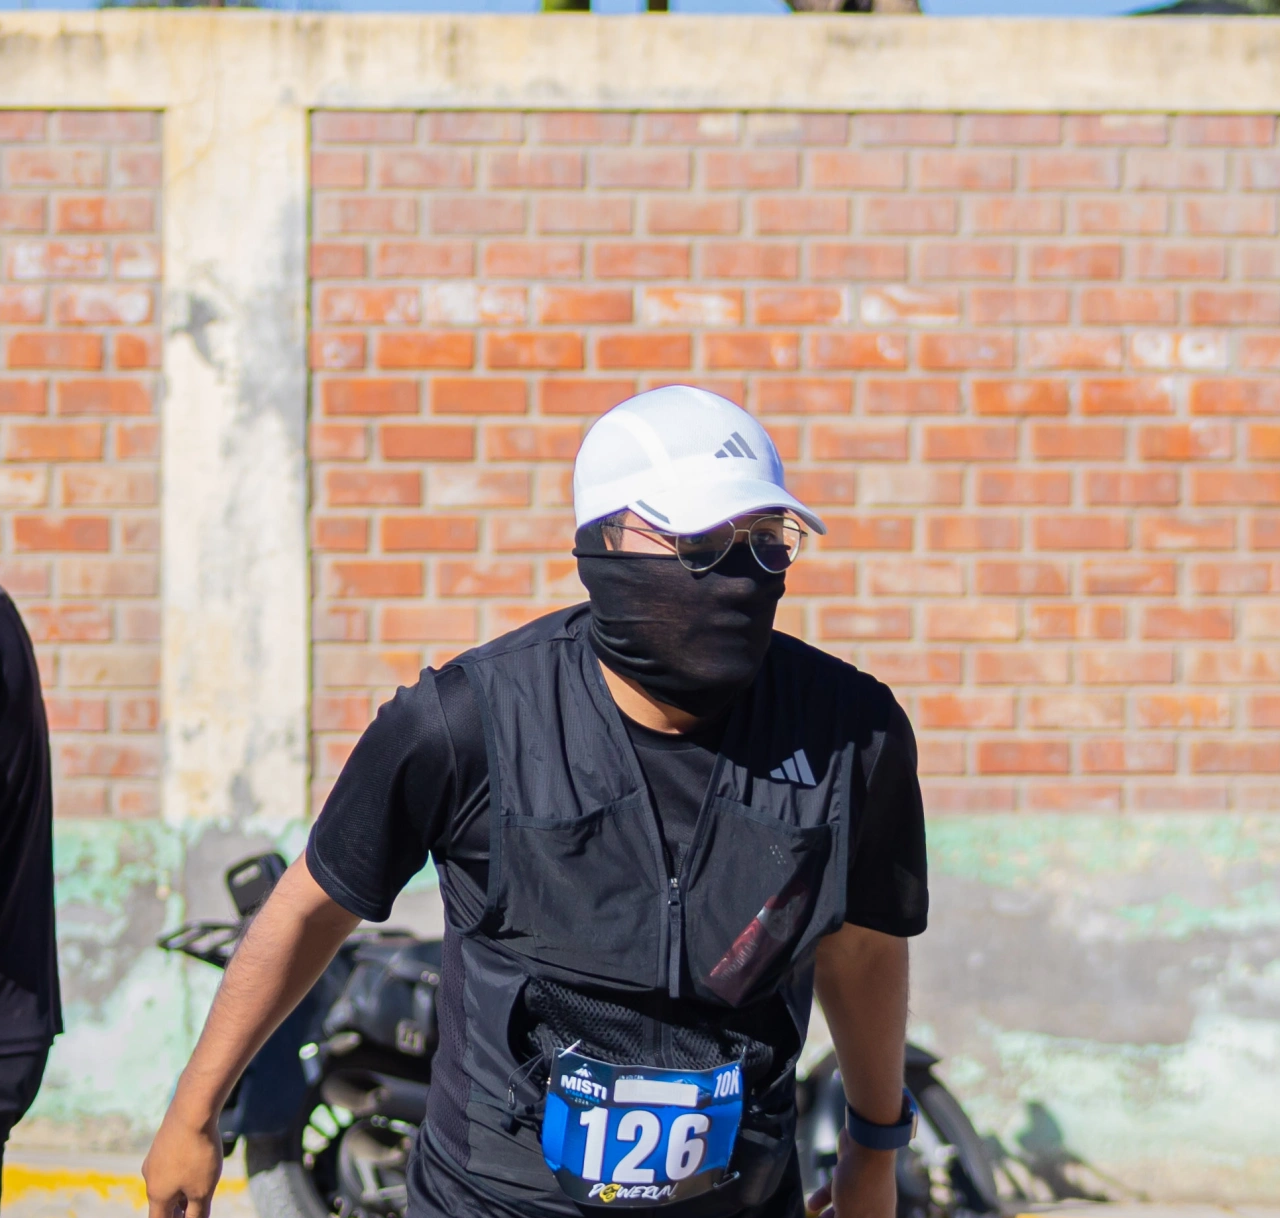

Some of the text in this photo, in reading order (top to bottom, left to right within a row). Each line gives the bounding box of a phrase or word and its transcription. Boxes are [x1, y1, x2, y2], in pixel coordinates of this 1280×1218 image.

[561, 1075, 607, 1100] MISTI
[714, 1069, 740, 1098] 10K
[579, 1106, 711, 1184] 126
